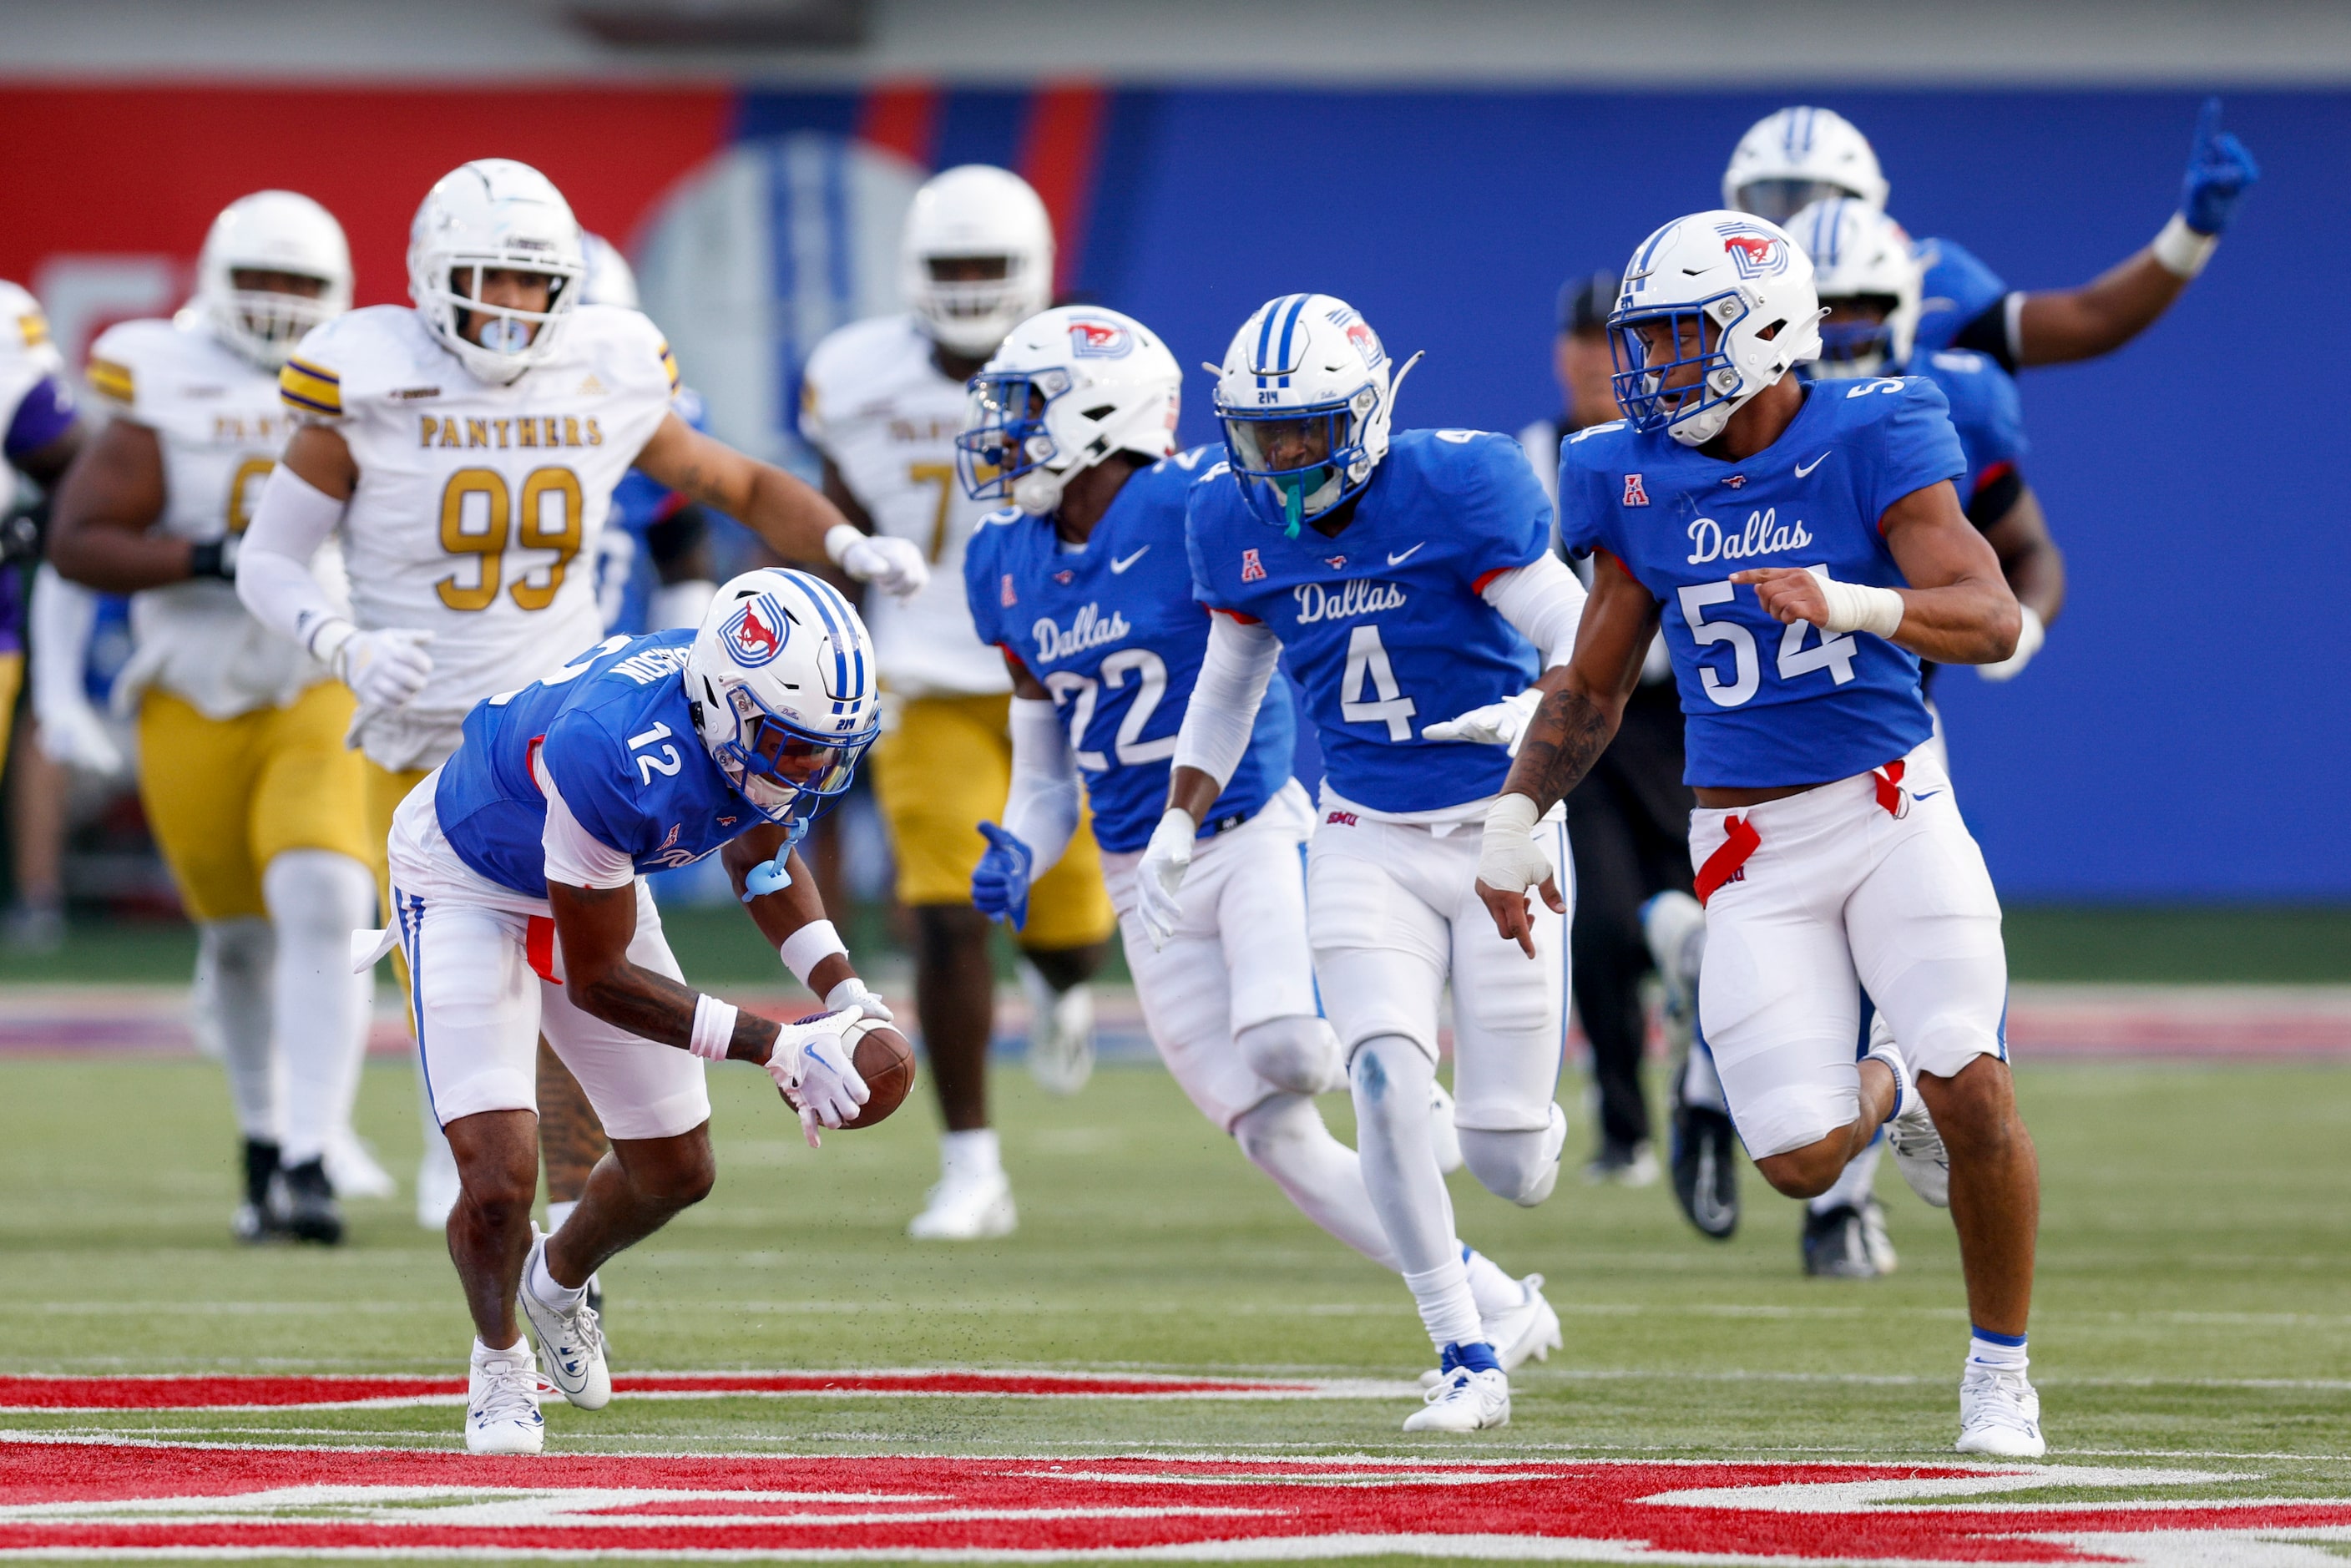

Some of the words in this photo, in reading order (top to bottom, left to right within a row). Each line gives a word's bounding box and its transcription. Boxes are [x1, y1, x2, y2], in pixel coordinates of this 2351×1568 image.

[421, 414, 604, 448] PANTHERS
[435, 466, 584, 613] 99
[1687, 507, 1813, 565] Dallas
[1293, 578, 1408, 625] Dallas
[1032, 601, 1131, 664] Dallas
[1676, 563, 1858, 707] 54
[1044, 648, 1178, 772] 22
[1340, 624, 1418, 742] 4
[781, 707, 800, 721] Dallas
[836, 718, 856, 731] 214
[627, 721, 682, 787] 12
[1326, 811, 1359, 827] SMU
